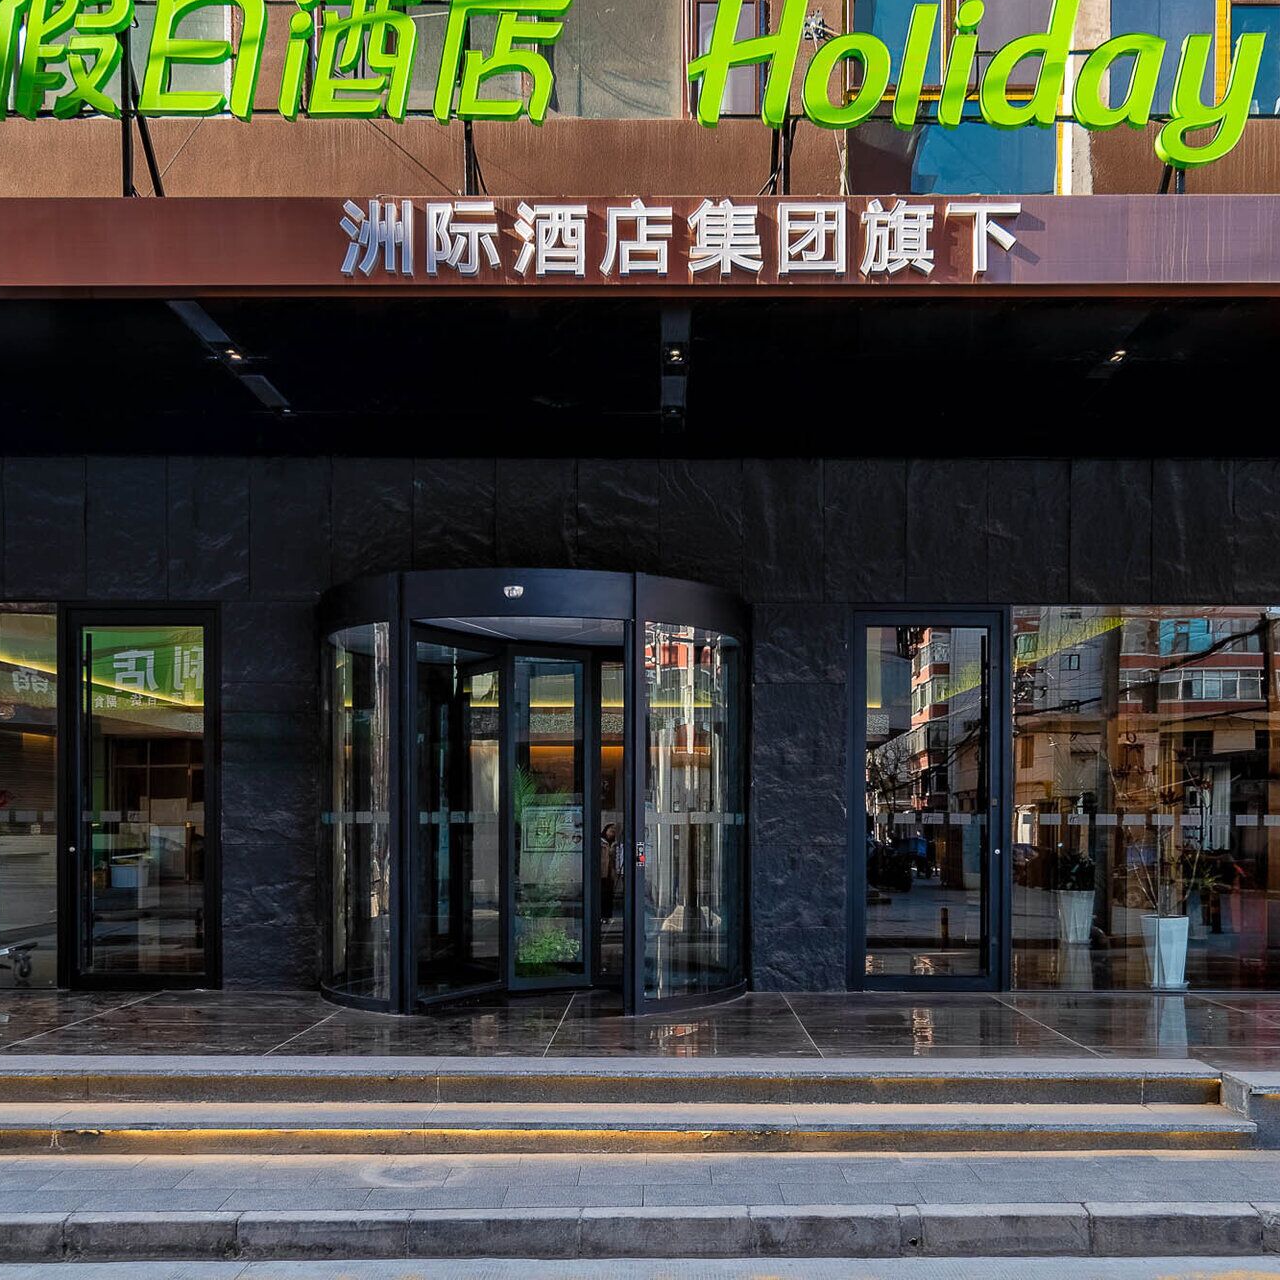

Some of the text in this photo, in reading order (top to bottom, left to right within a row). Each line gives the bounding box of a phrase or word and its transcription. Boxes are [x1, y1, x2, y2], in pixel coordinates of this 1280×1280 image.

[340, 198, 1022, 277] 洲际酒店集团旗下
